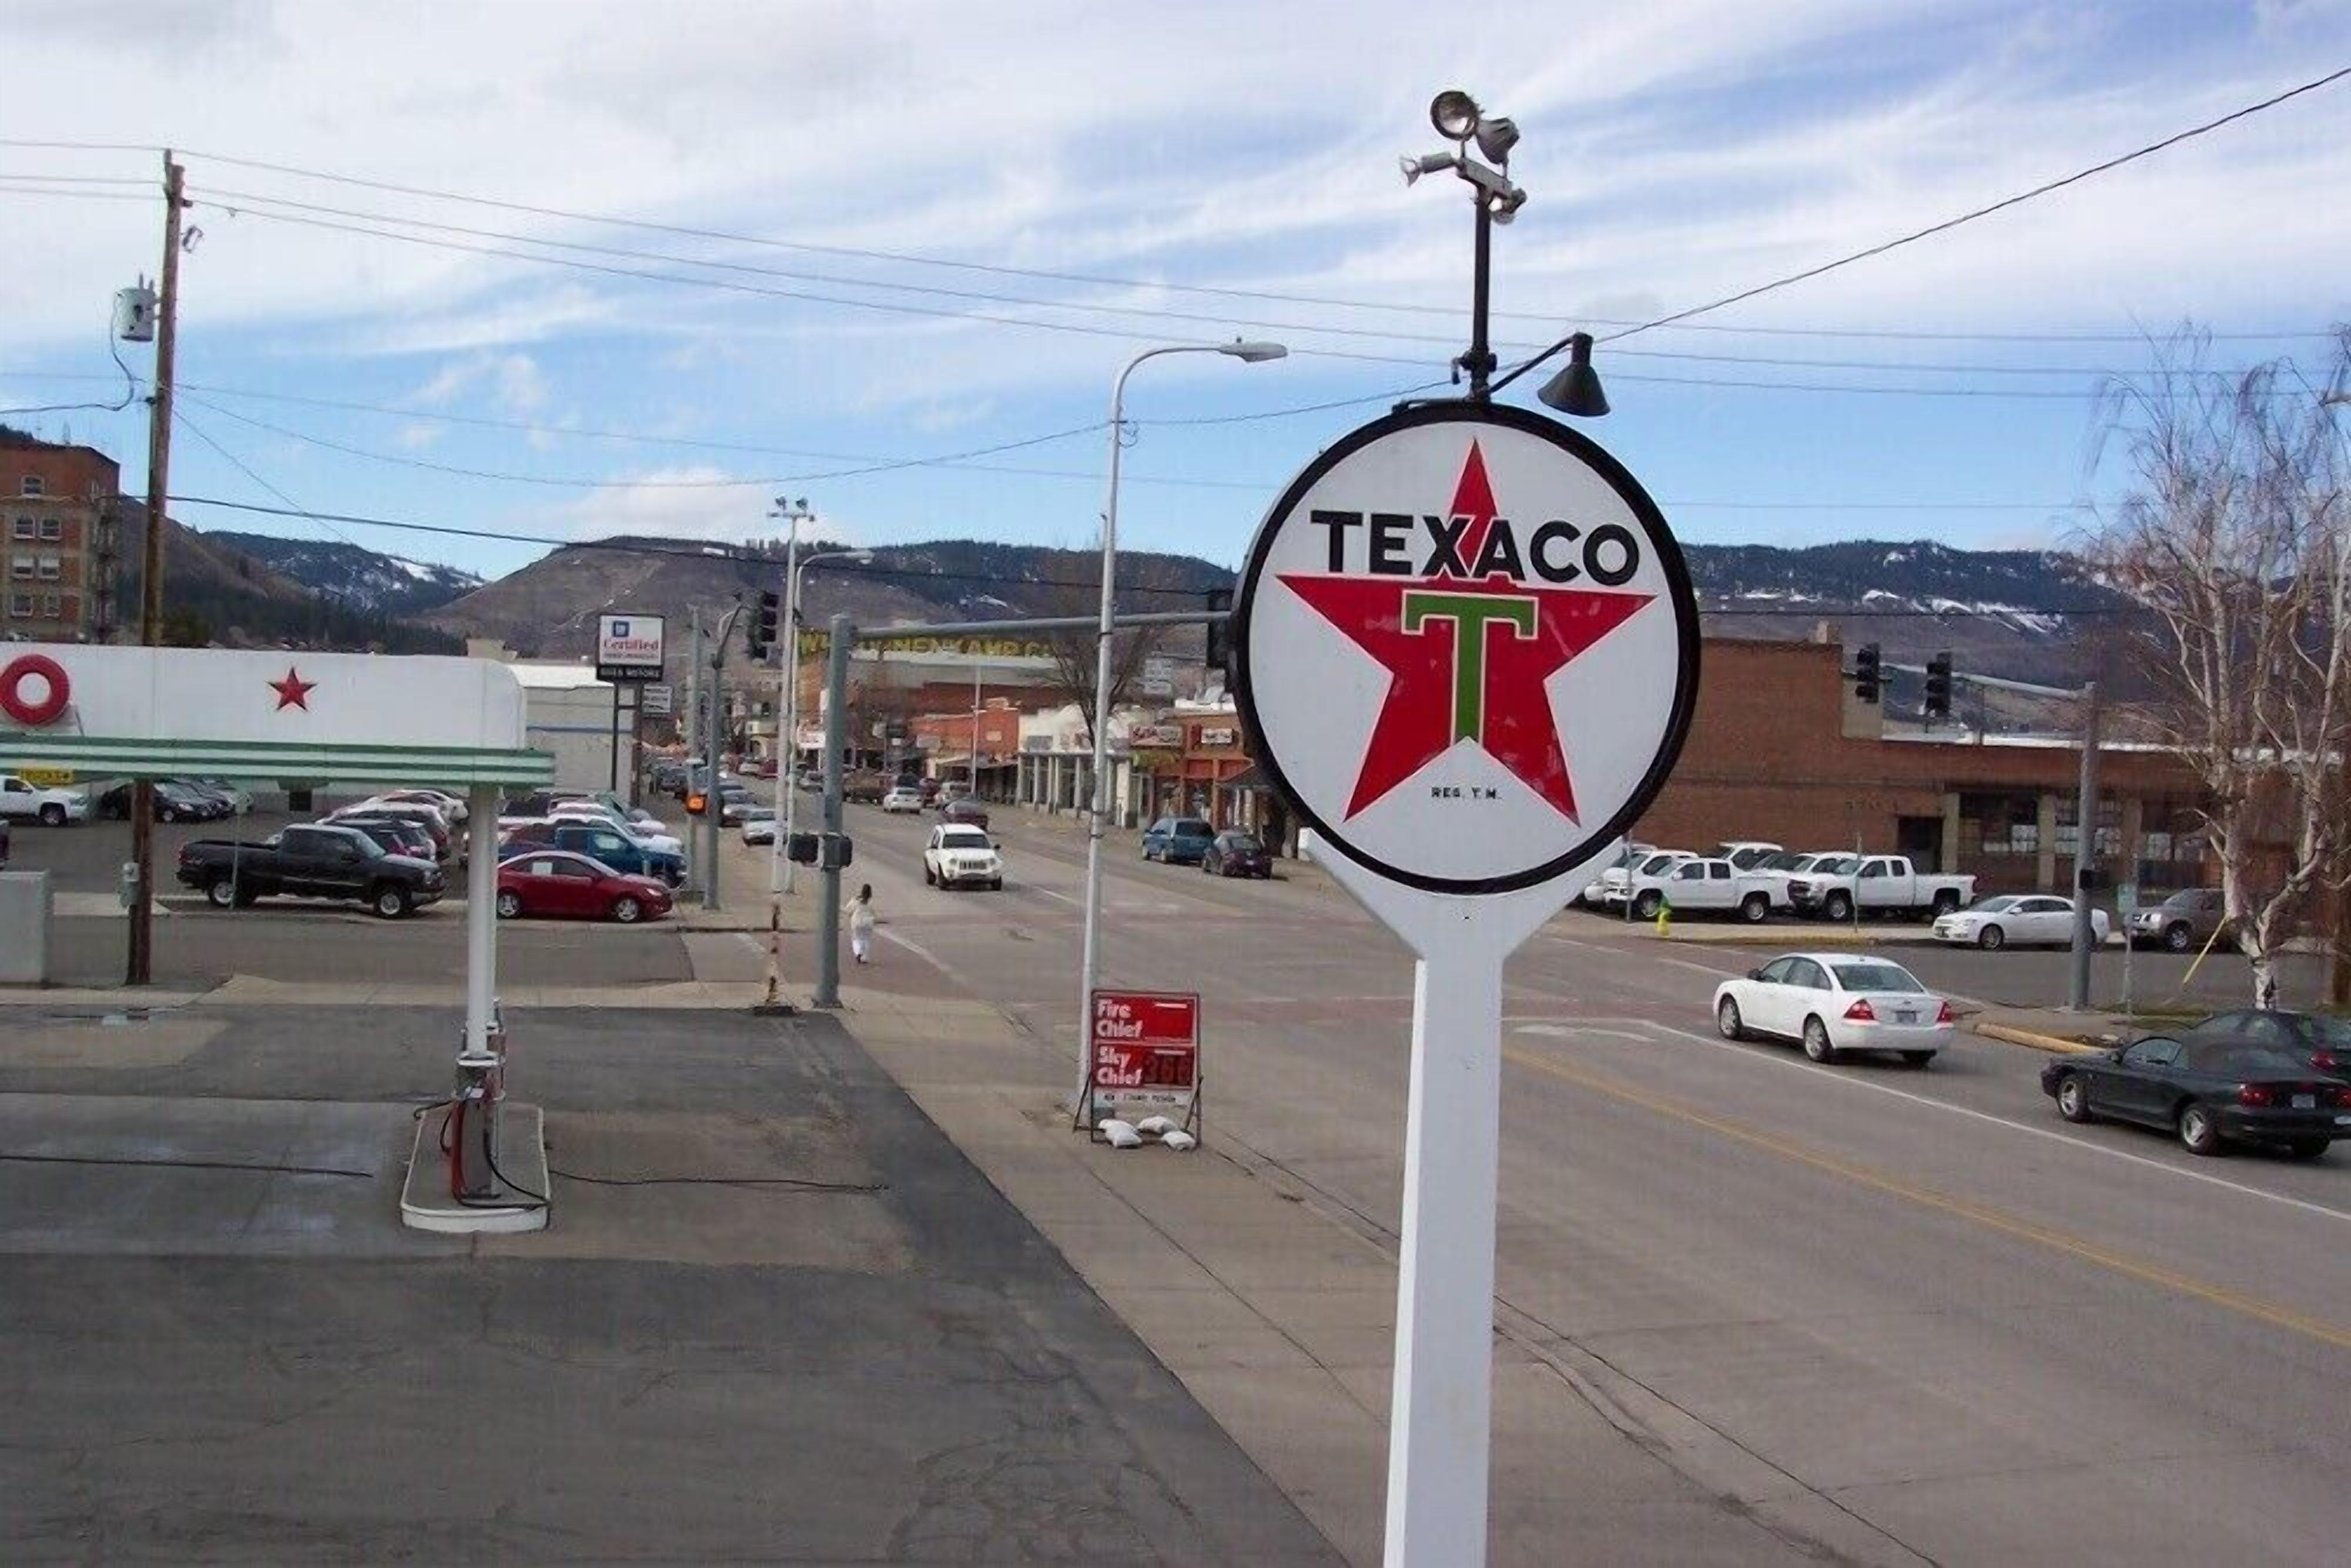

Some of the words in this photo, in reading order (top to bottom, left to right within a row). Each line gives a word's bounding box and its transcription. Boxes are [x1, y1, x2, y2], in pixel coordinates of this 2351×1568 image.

[1311, 510, 1640, 586] TEXACO
[1401, 589, 1539, 743] T
[0, 654, 70, 725] O
[1097, 999, 1131, 1018] Fire
[1096, 1020, 1144, 1038] Chief
[1099, 1045, 1132, 1068] Sky
[1097, 1067, 1143, 1084] Chief
